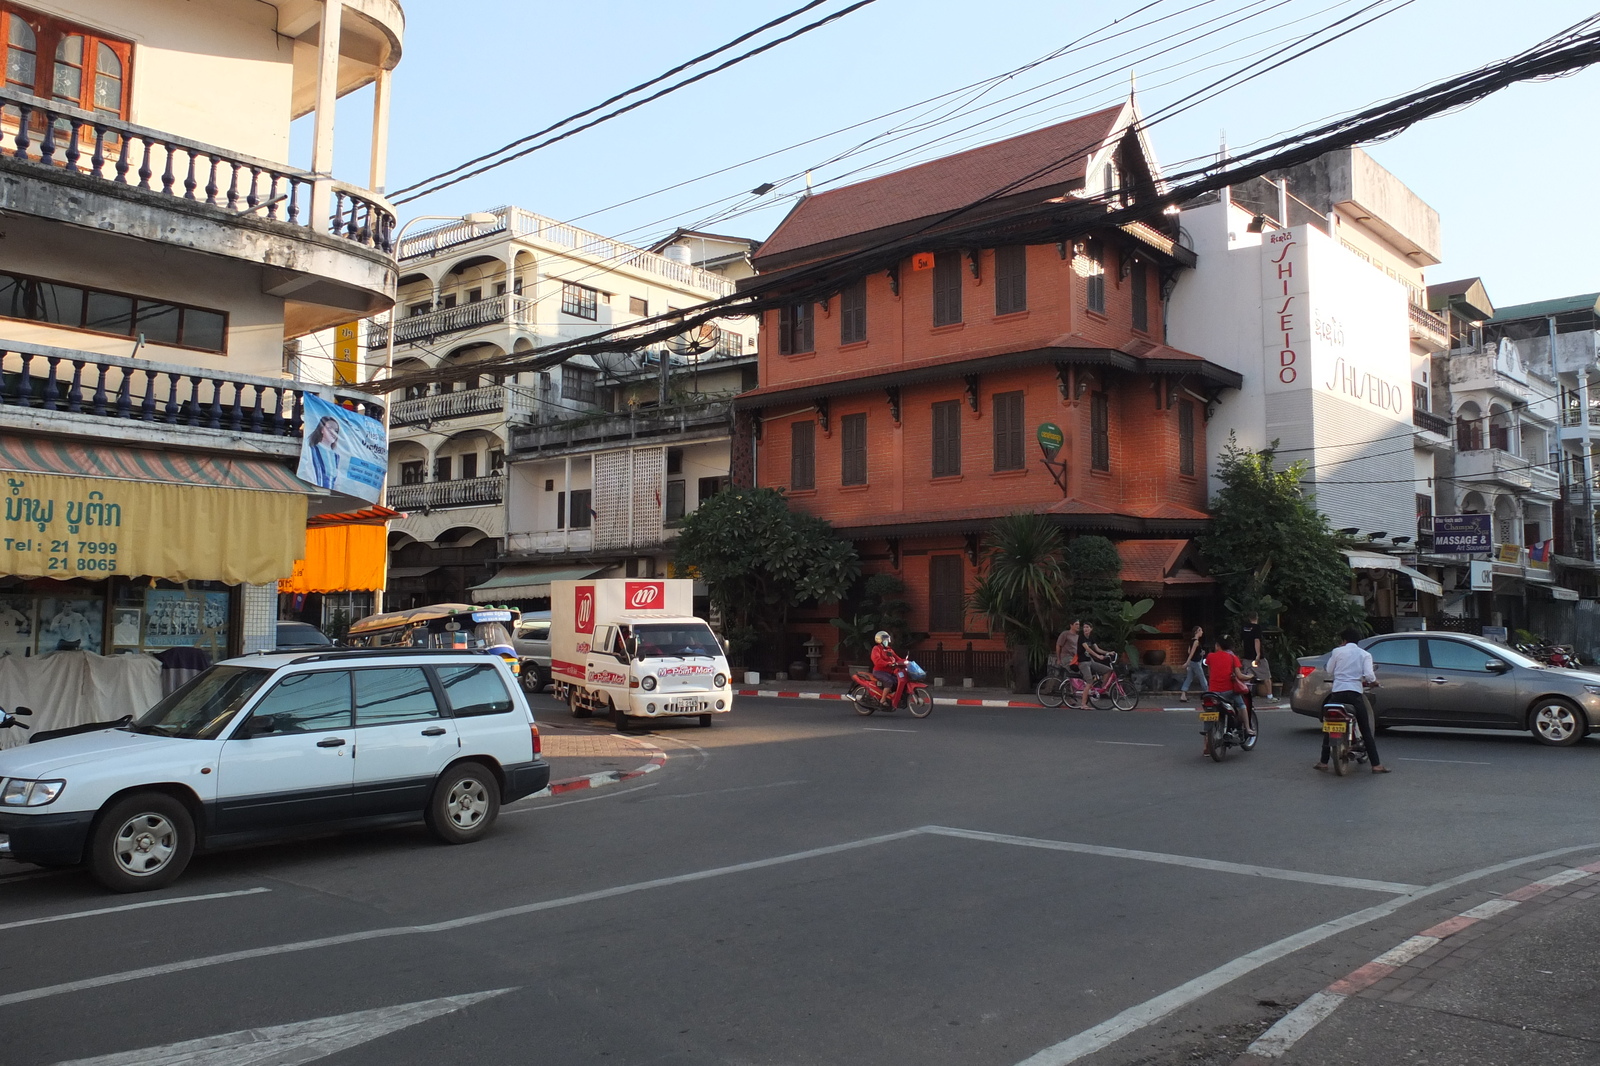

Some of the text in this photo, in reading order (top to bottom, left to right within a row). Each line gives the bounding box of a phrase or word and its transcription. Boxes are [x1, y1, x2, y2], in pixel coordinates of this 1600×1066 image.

[1271, 242, 1297, 384] SHISEIDO
[1326, 356, 1403, 415] SHISEIDO
[1443, 522, 1474, 532] Champa
[1436, 535, 1487, 545] MASSAGE &
[50, 540, 69, 553] 21
[77, 541, 118, 555] 7999
[48, 557, 117, 571] 21 8065
